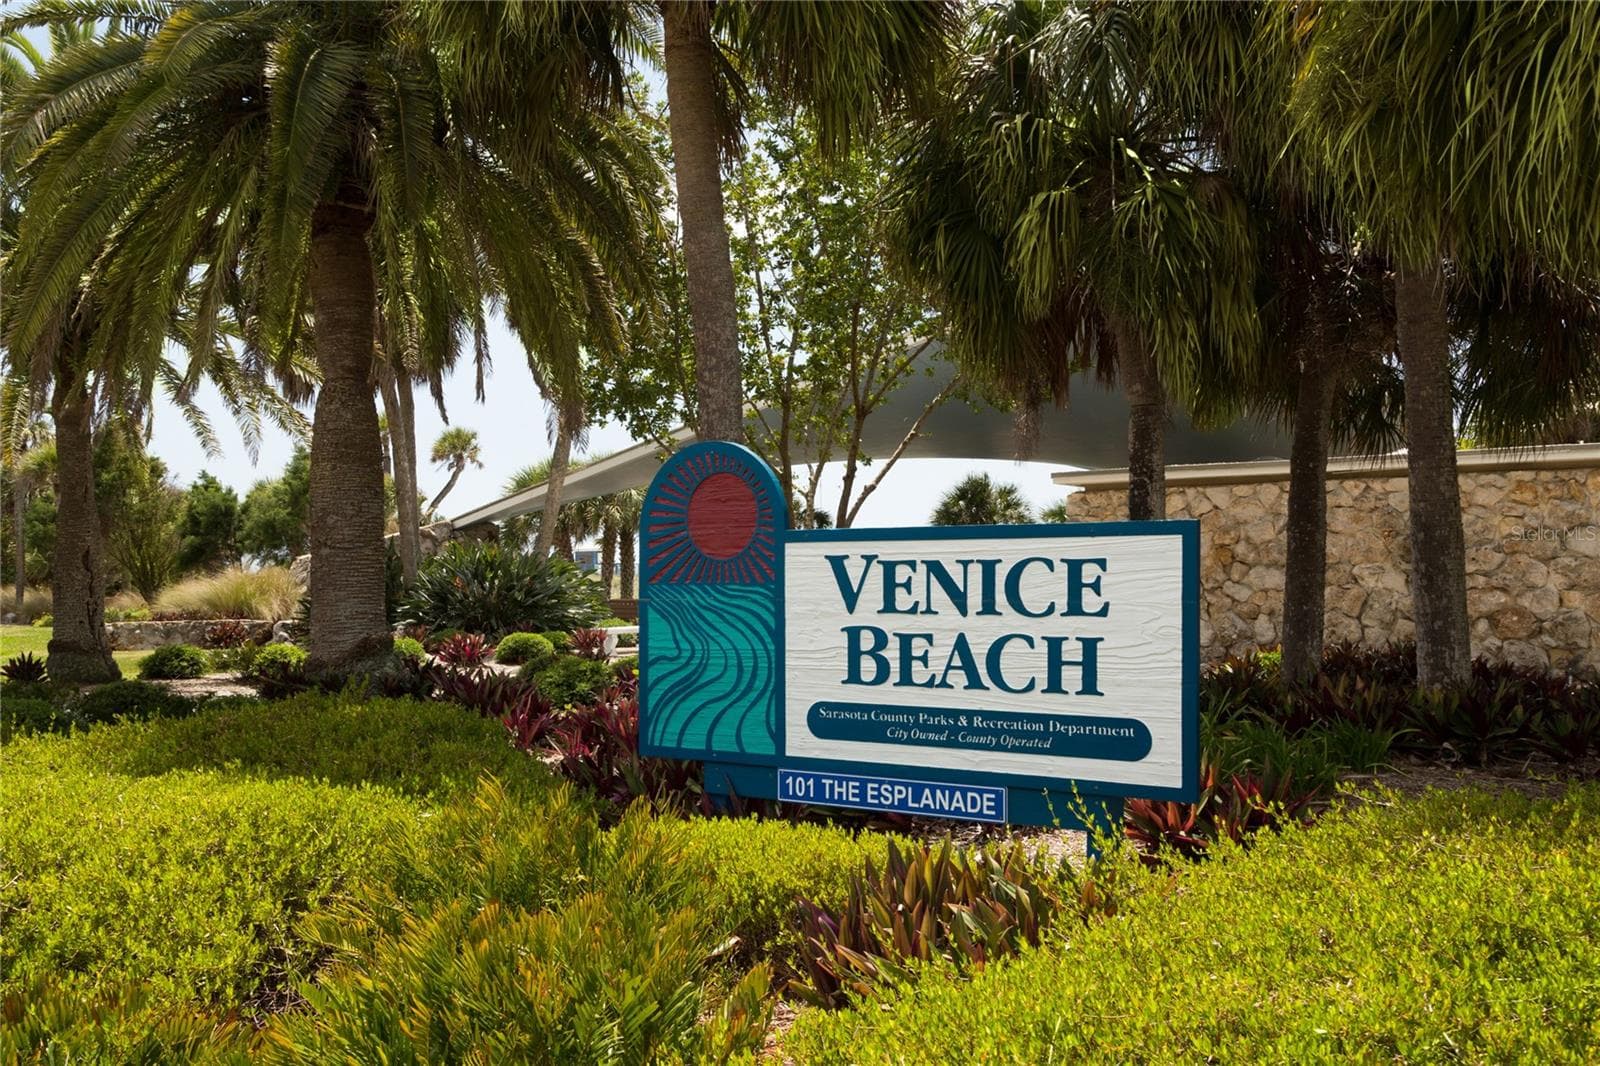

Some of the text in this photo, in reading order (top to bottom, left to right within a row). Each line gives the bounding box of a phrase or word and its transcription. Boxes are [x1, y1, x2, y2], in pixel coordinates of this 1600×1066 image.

[824, 553, 1110, 619] VENICE
[840, 625, 1105, 697] BEACH
[818, 706, 1135, 738] Sarasota County Parks & Recreation Department
[886, 726, 909, 741] City
[910, 728, 948, 742] Owned
[957, 731, 998, 747] County
[999, 734, 1052, 749] Operated
[785, 776, 996, 815] 101 THE ESPLANADE
